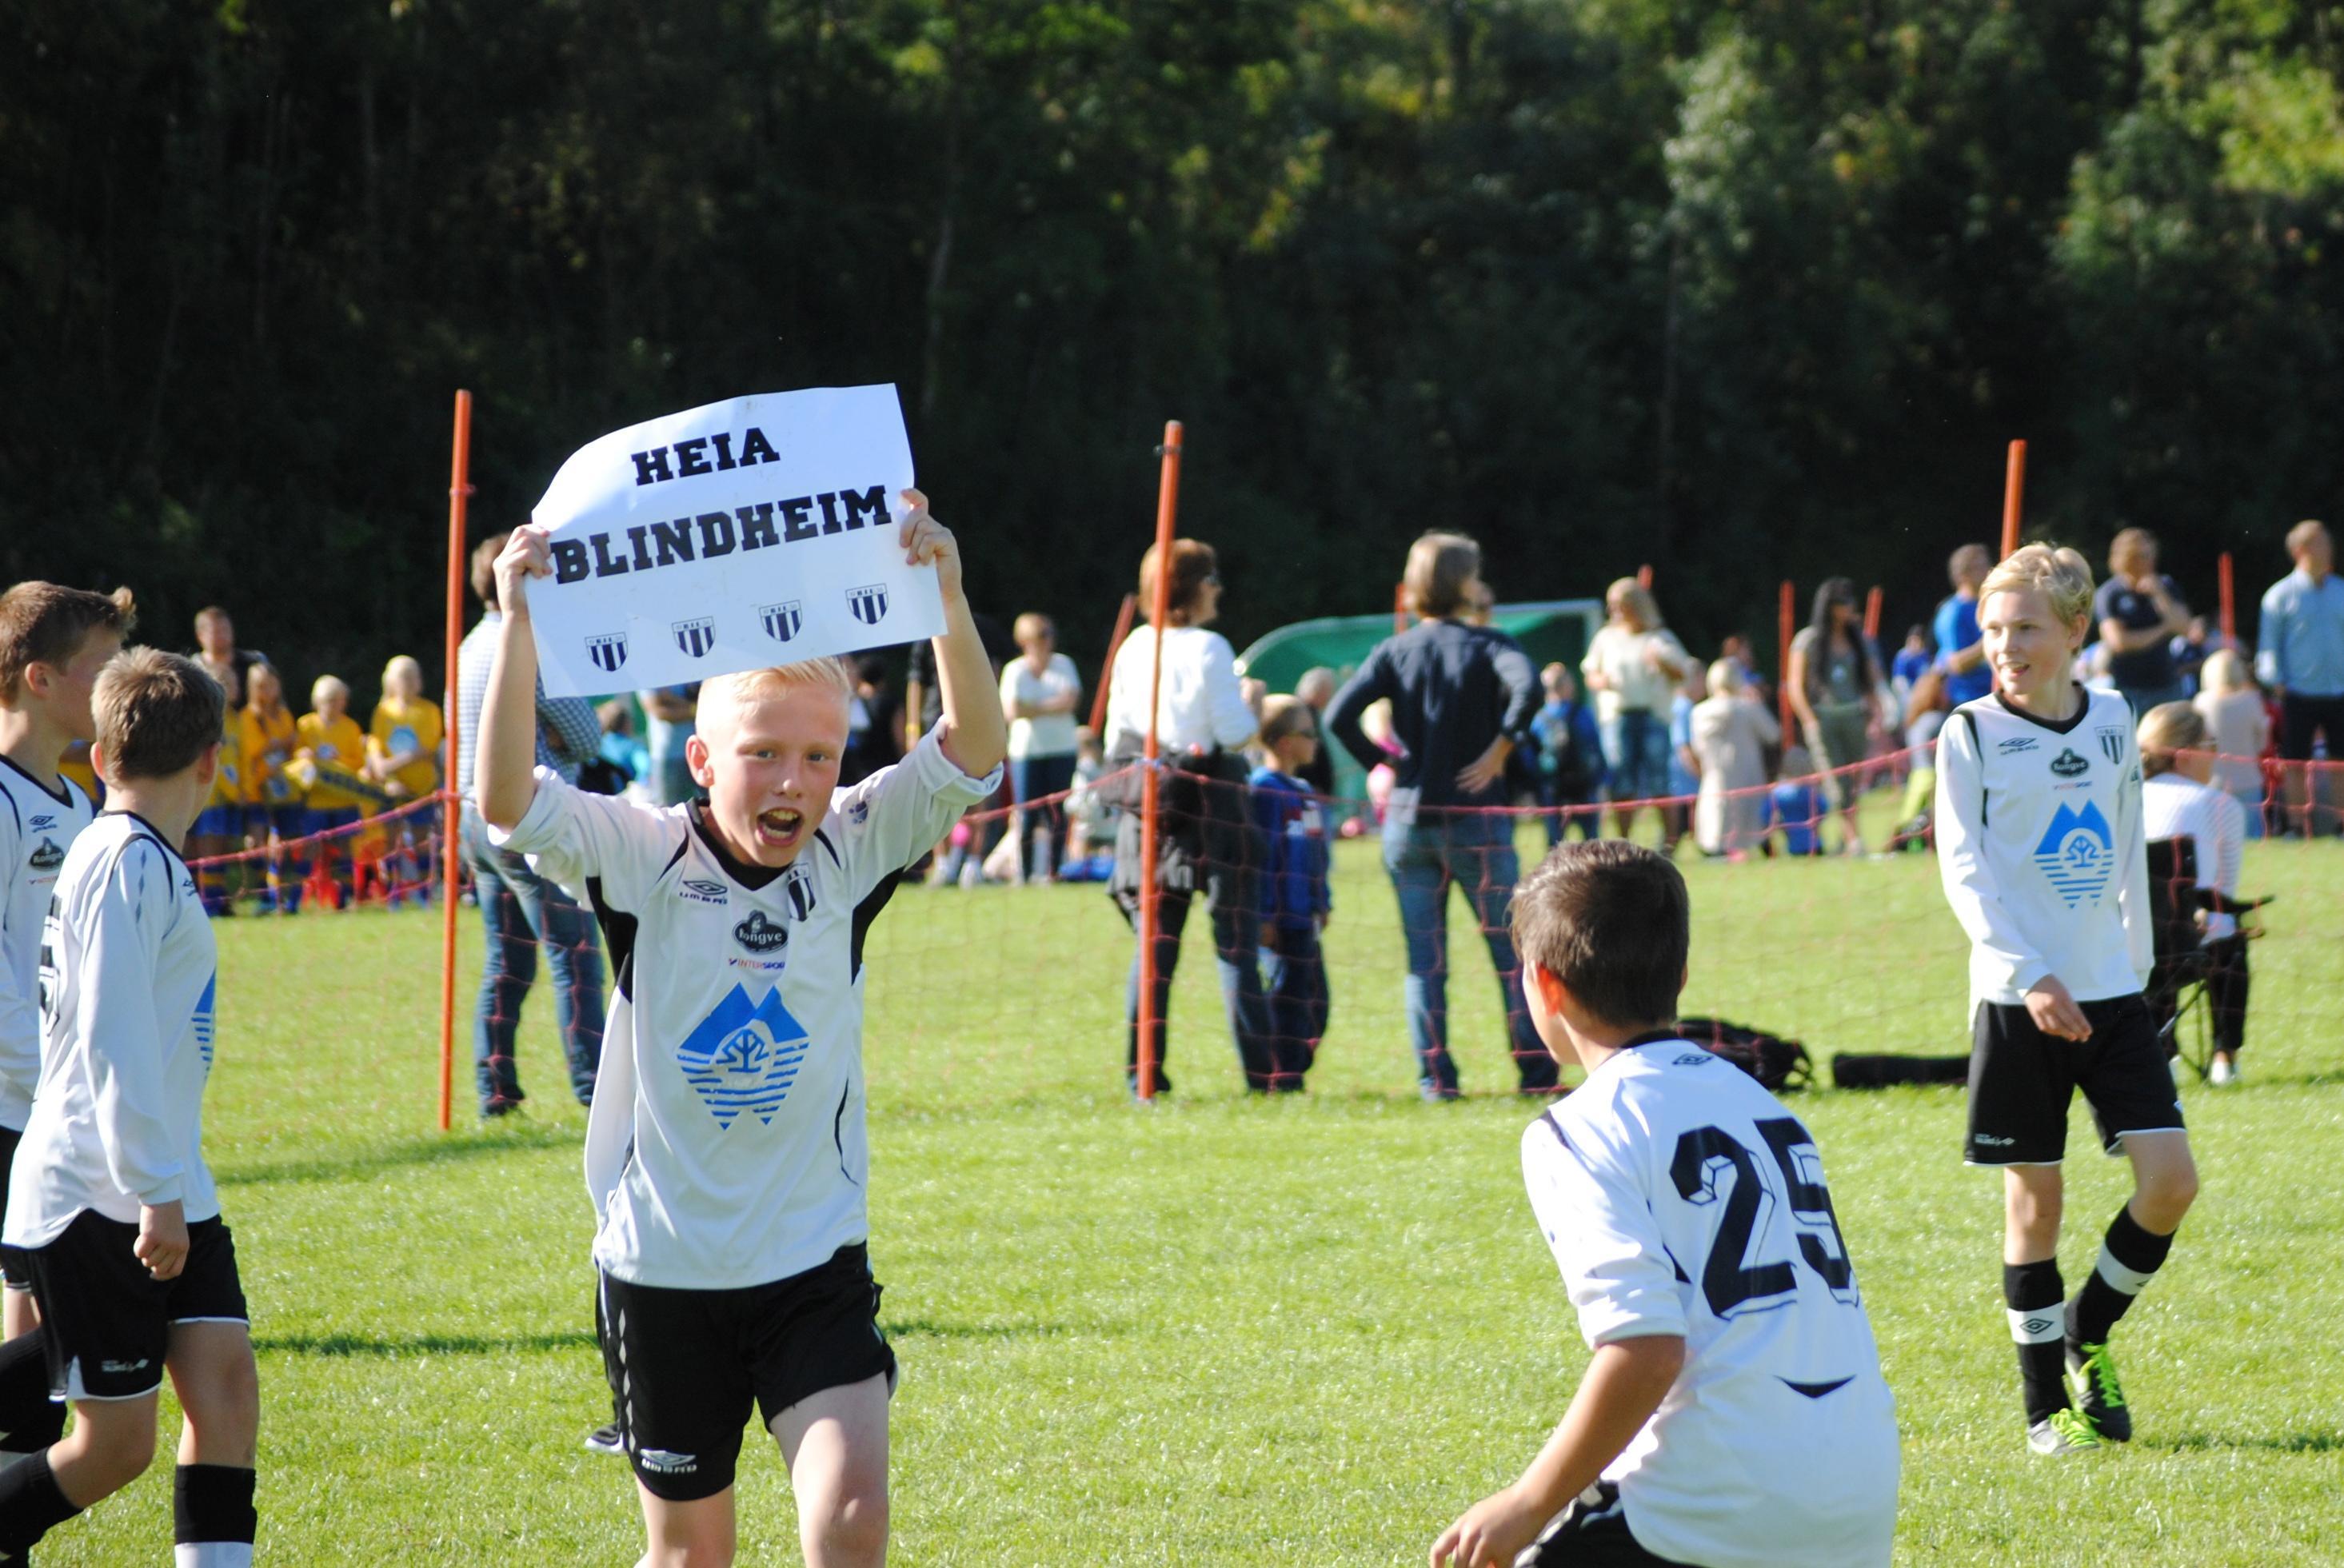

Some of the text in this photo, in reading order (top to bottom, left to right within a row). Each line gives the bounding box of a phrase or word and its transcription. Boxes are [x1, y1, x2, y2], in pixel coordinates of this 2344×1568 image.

[631, 427, 781, 486] HEIA
[549, 485, 892, 585] BLINDHEIM
[738, 959, 785, 970] INTERSPOR
[1670, 1117, 1859, 1322] 25
